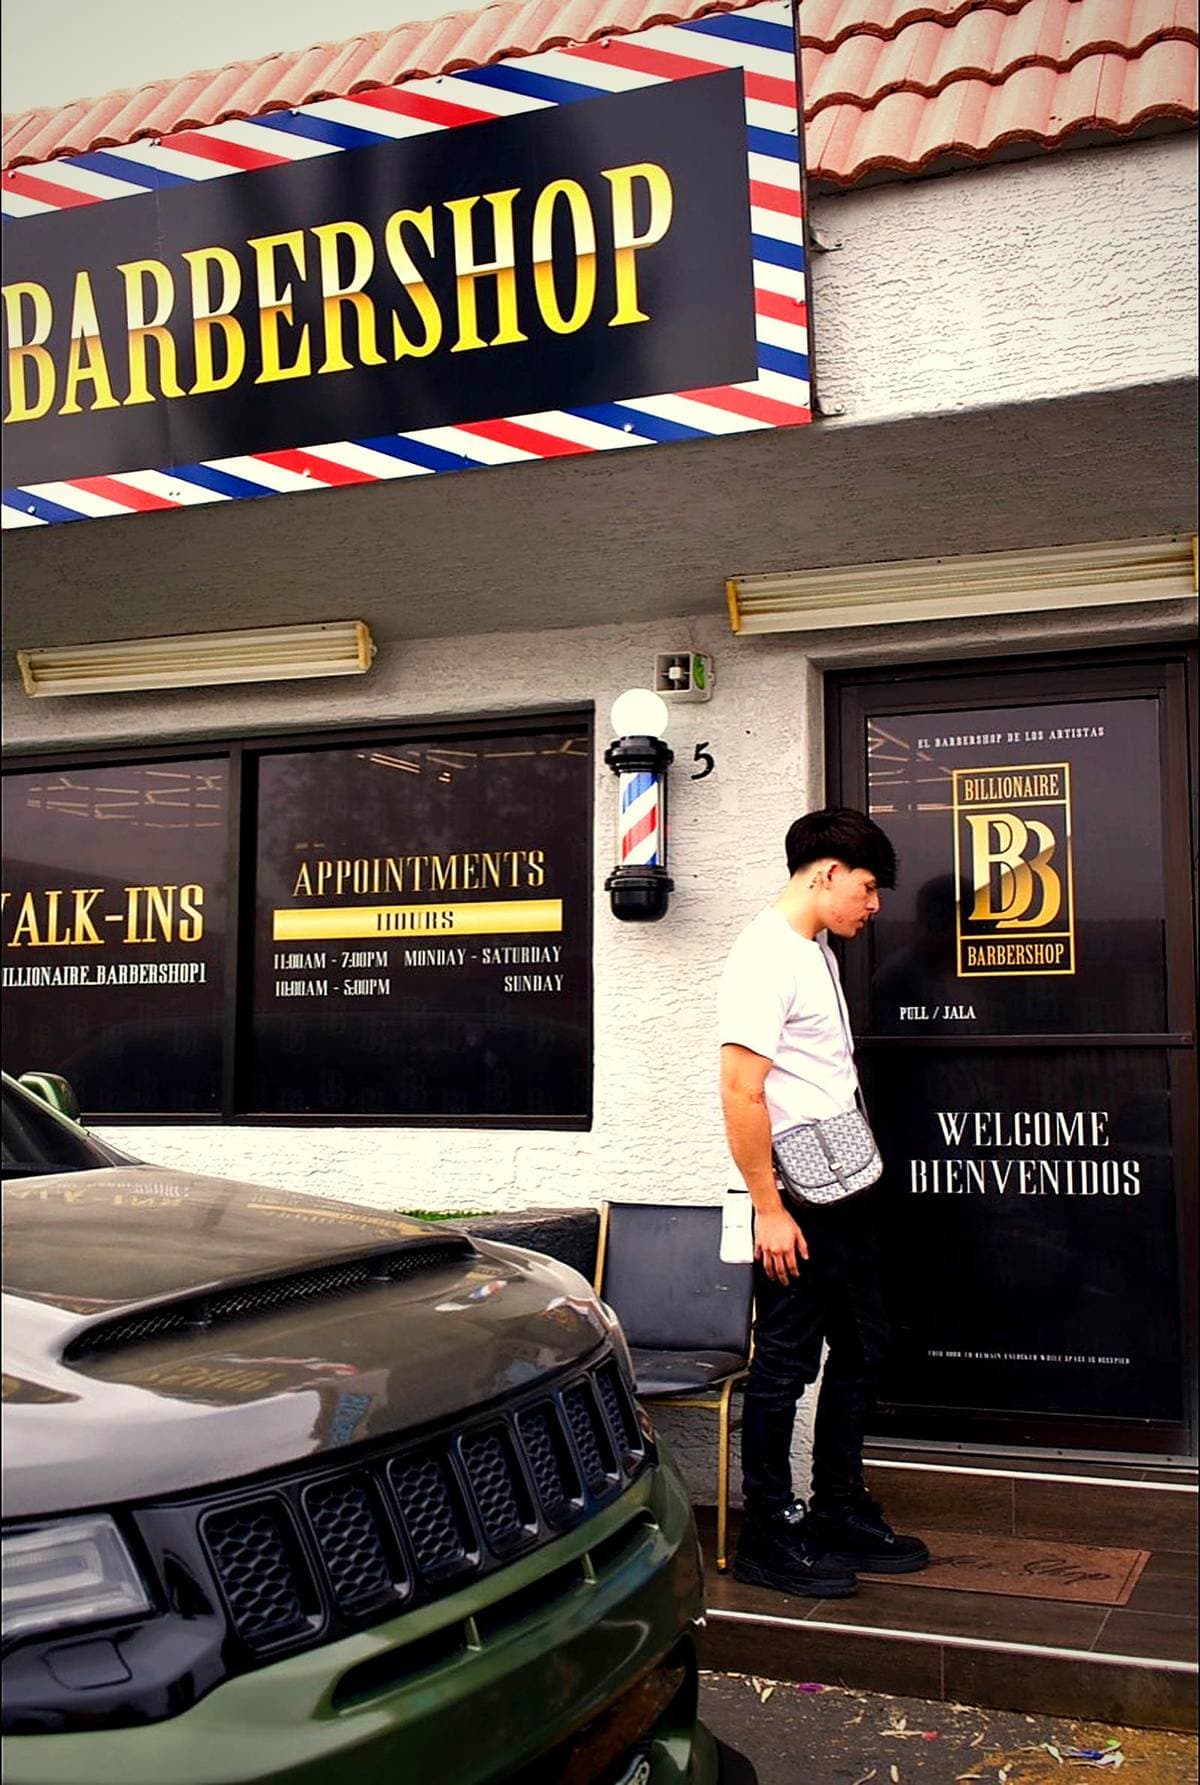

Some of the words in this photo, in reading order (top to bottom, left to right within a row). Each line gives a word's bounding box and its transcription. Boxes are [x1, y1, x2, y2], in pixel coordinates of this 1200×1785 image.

[1, 161, 674, 424] BARBERSHOP
[917, 738, 931, 749] EL
[934, 733, 1002, 748] BARBERSHOP
[1007, 732, 1021, 743] DE
[1025, 730, 1044, 742] LOS
[1049, 726, 1105, 740] ARTISTAS
[690, 742, 715, 780] 5
[964, 774, 1060, 801] BILLIONAIRE
[292, 850, 544, 897] APPOINTMENTS
[1, 884, 204, 947] ALK-INS
[377, 911, 454, 931] HOURS
[274, 952, 326, 969] 11:00AM
[341, 950, 388, 968] 7:00PM
[404, 949, 466, 967] MONDAY
[482, 946, 562, 964] SATURDAY
[967, 943, 1065, 966] BARBERSHOP
[343, 978, 390, 996] 5:00PM
[504, 974, 563, 993] SUNDAY
[899, 1006, 929, 1021] PULL
[942, 1005, 977, 1020] JALA
[935, 1111, 1109, 1147] WELCOME
[910, 1159, 1141, 1196] BIENVENIDOS
